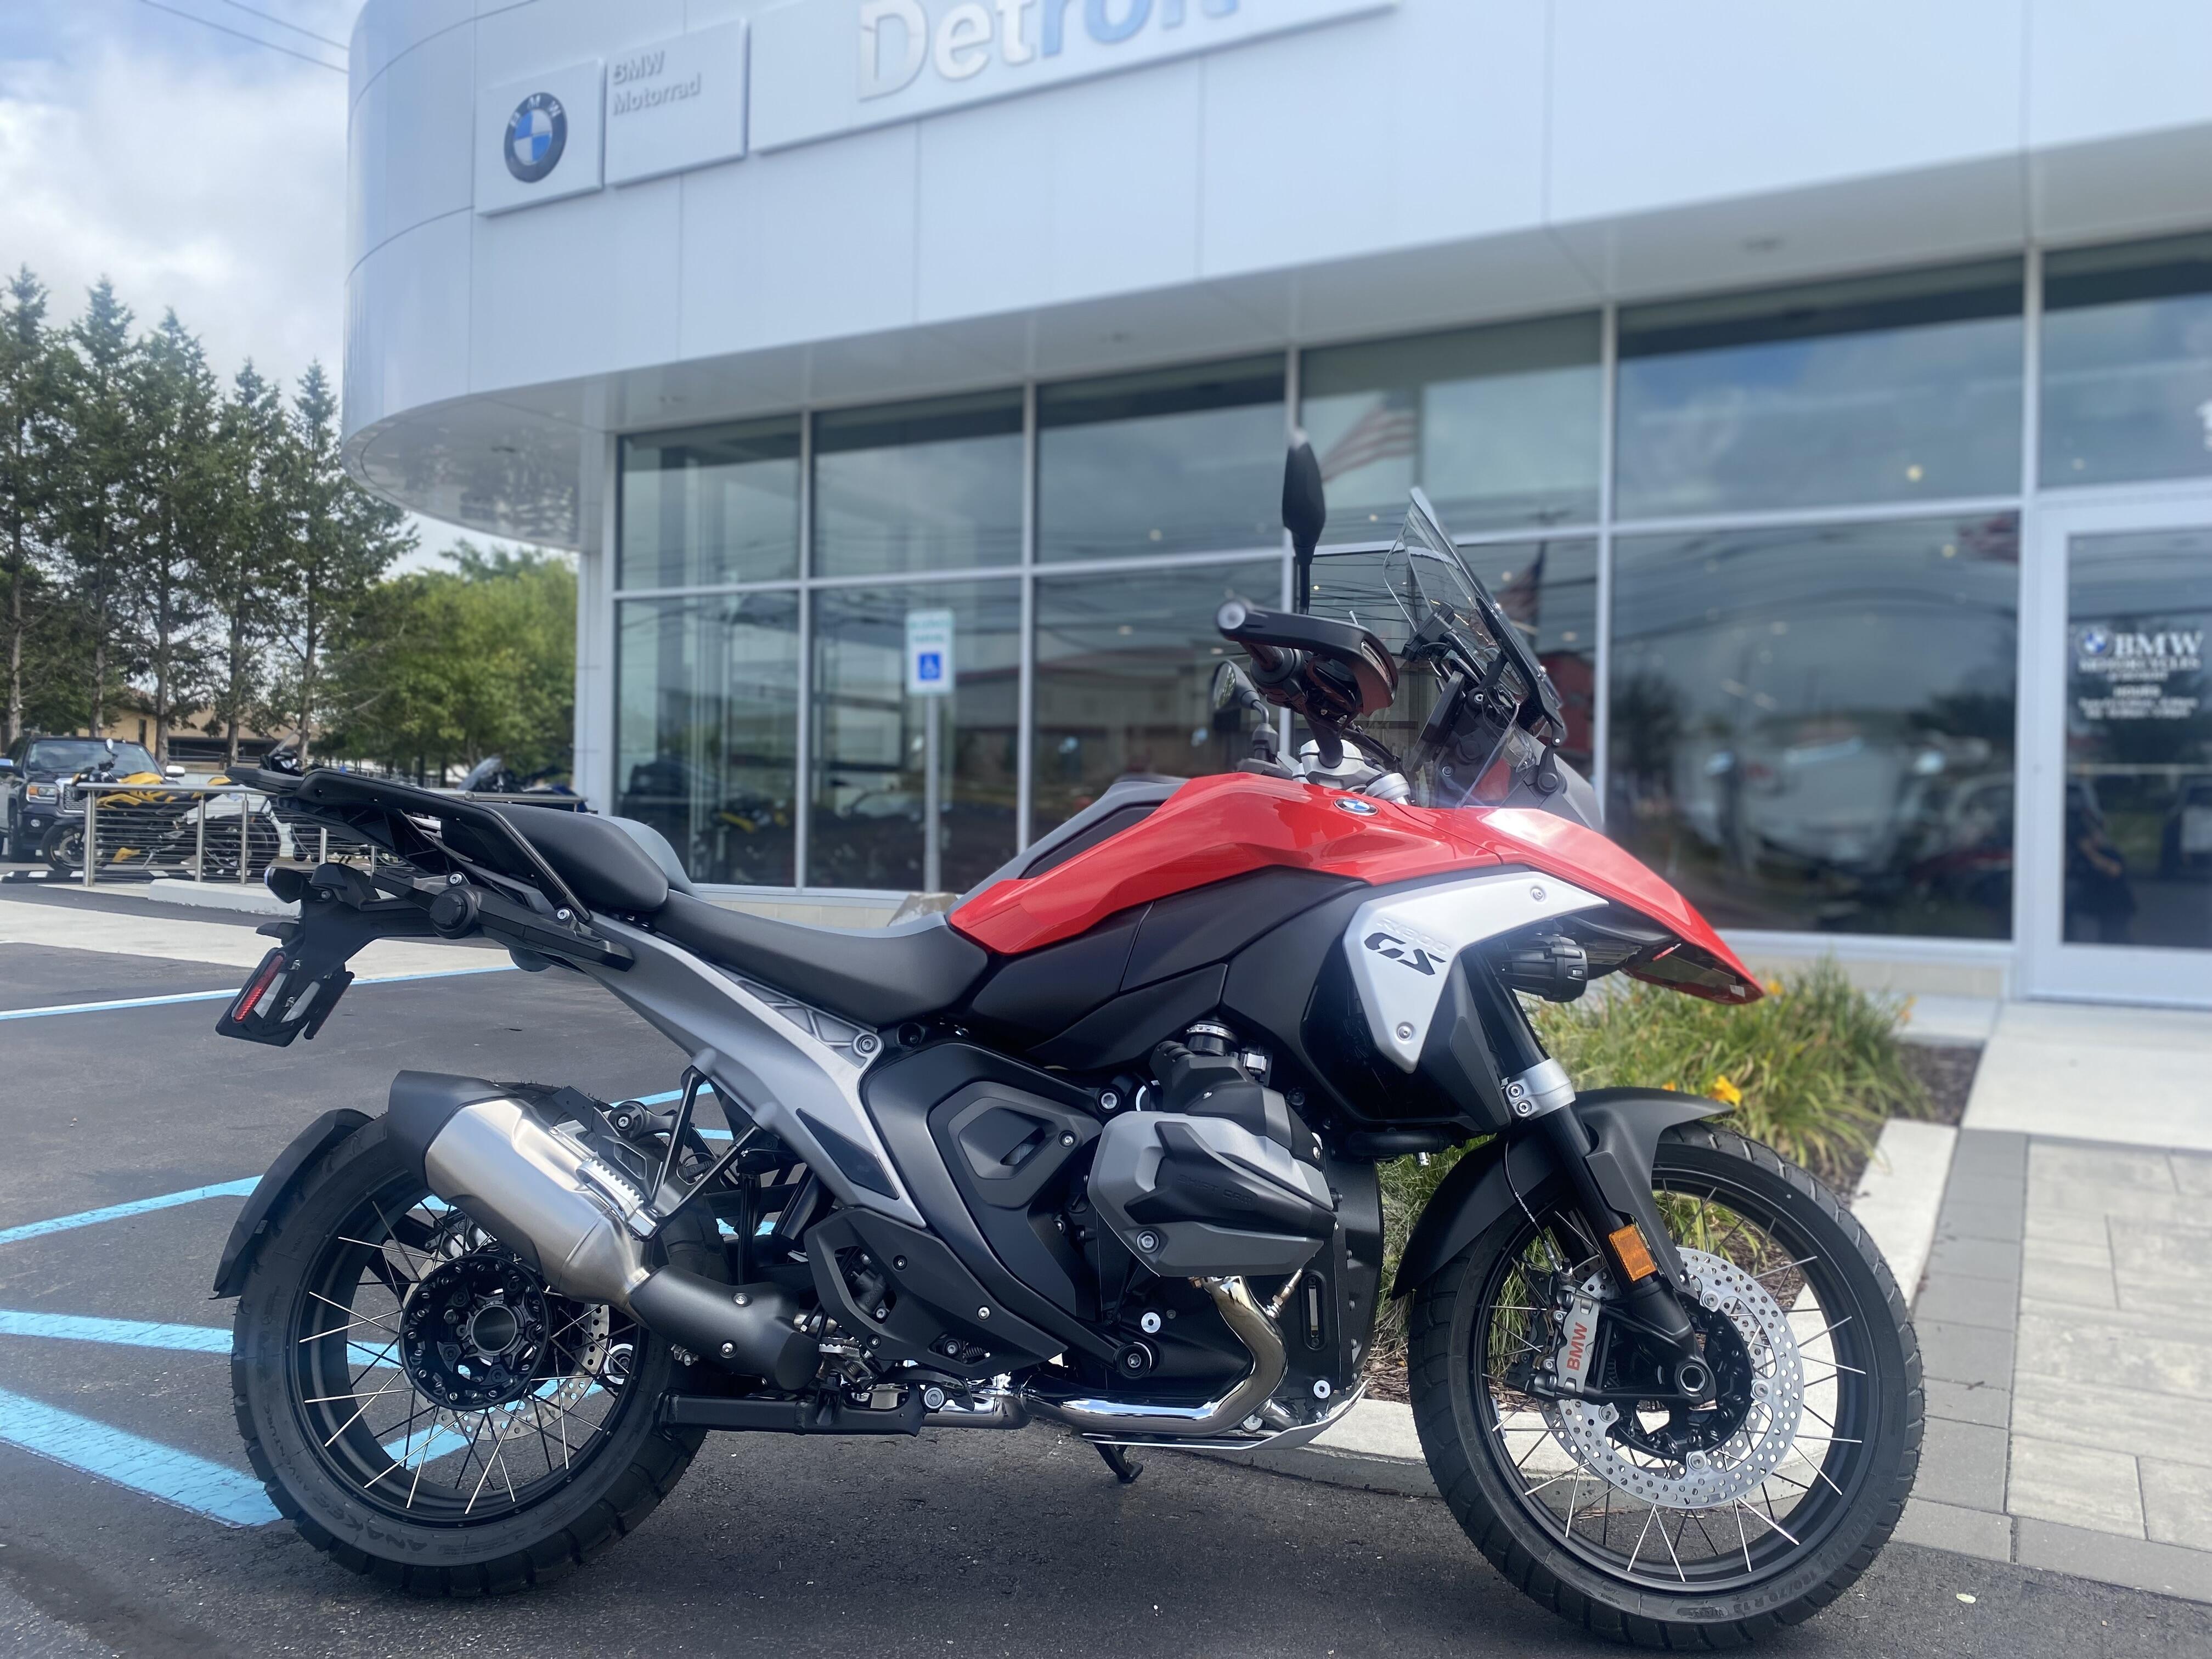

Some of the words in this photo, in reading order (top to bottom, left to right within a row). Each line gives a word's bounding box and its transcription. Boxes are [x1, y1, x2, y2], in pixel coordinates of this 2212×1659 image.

[611, 50, 665, 86] BMW
[858, 0, 1239, 103] Detro
[508, 94, 561, 128] BMW
[611, 71, 702, 116] Motorrad
[2114, 630, 2204, 657] BMW
[1364, 932, 1447, 976] GS
[1566, 1322, 1588, 1371] BMW
